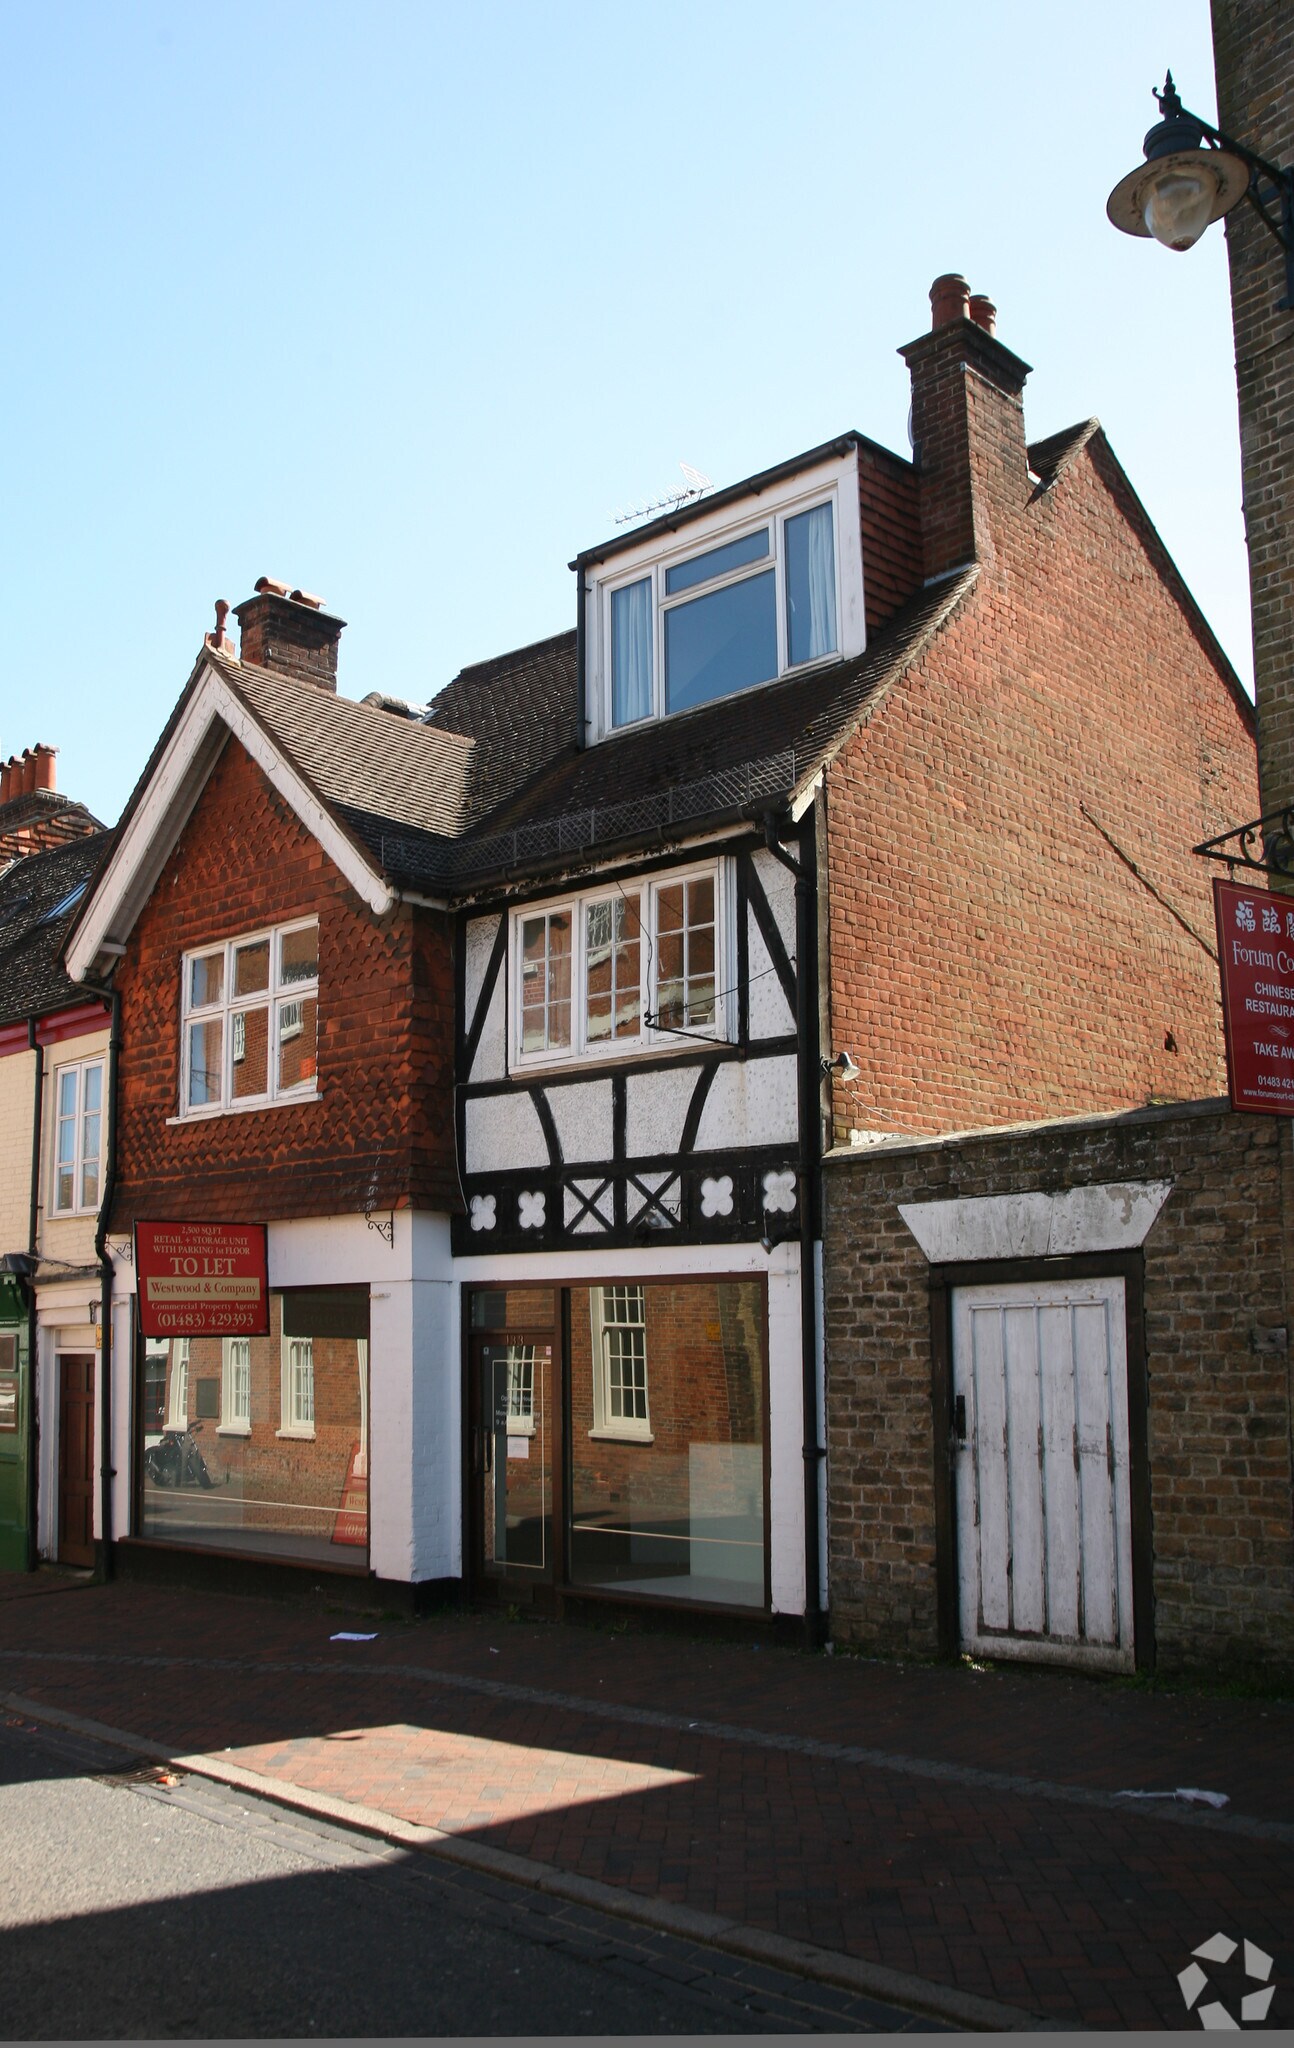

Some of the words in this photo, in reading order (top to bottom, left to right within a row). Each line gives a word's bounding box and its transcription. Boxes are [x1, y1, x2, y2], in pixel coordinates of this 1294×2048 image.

[1232, 940, 1275, 971] Forum
[1255, 981, 1294, 1000] CHINESE
[1253, 1041, 1279, 1058] TAKE
[1258, 1075, 1280, 1087] 01483
[181, 1226, 200, 1235] 2,500
[154, 1235, 182, 1244] RETAIL
[192, 1236, 228, 1245] STORAGE
[229, 1237, 248, 1245] UNIT
[153, 1245, 177, 1254] WITH
[178, 1246, 214, 1254] PARKING
[225, 1247, 250, 1255] FLOOR
[169, 1257, 198, 1275] TO
[203, 1258, 236, 1275] LET
[151, 1282, 201, 1293] Westwood
[203, 1283, 212, 1293] &
[214, 1283, 257, 1296] Company
[151, 1302, 198, 1310] Commercial
[200, 1303, 231, 1311] Property
[234, 1303, 258, 1311] Agents
[157, 1312, 206, 1327] (01483)
[208, 1312, 254, 1327] 429393
